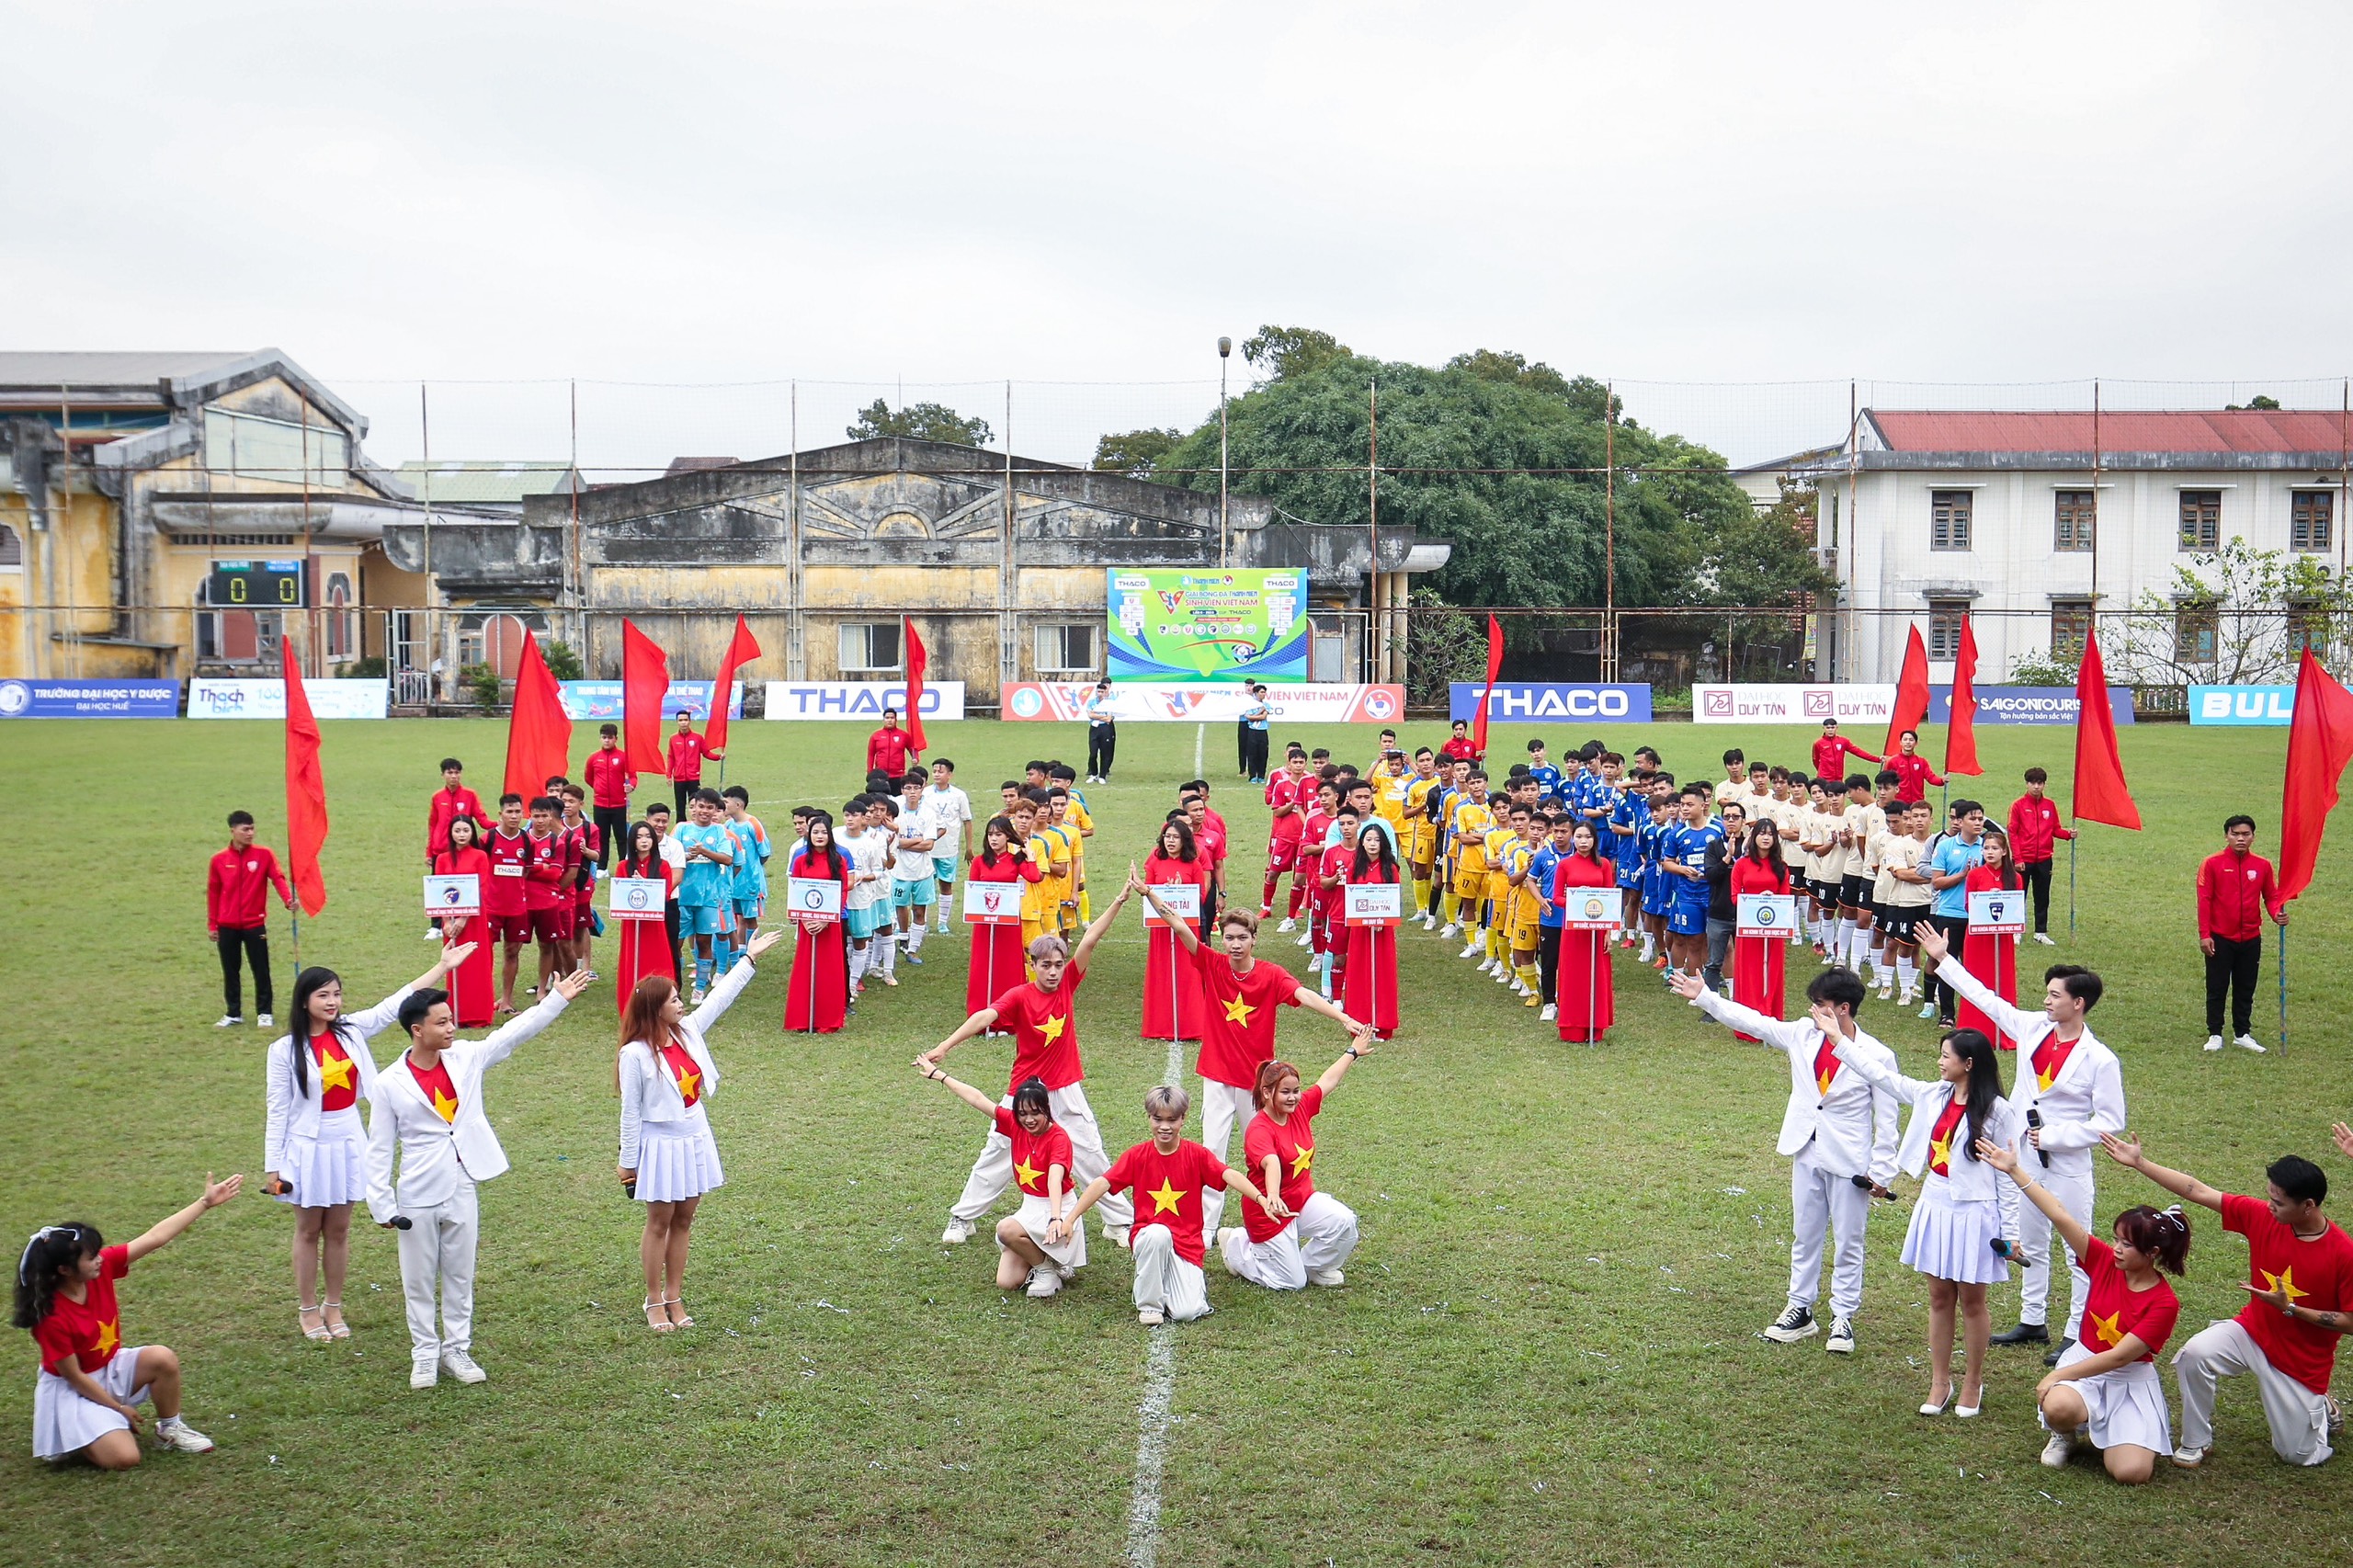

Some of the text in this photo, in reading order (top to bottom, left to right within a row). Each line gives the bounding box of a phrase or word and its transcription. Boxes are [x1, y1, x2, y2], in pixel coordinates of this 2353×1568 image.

[231, 578, 246, 603] 0
[279, 577, 295, 603] 0
[103, 689, 129, 701] HỌC
[129, 689, 138, 699] Y
[576, 686, 597, 695] TRUNG
[1320, 691, 1348, 701] NAM
[790, 689, 940, 712] THACO
[1472, 689, 1629, 716] THACO
[1980, 698, 2082, 710] SAIGONTOURIS
[2201, 692, 2293, 719] BUL
[1738, 704, 1760, 715] DUY
[1838, 704, 1860, 715] DUY
[1273, 856, 1281, 865] 12
[1462, 879, 1470, 889] 17
[894, 888, 903, 897] 18
[1179, 898, 1189, 909] TÀI
[1900, 922, 1907, 934] 14
[1518, 929, 1526, 940] 19
